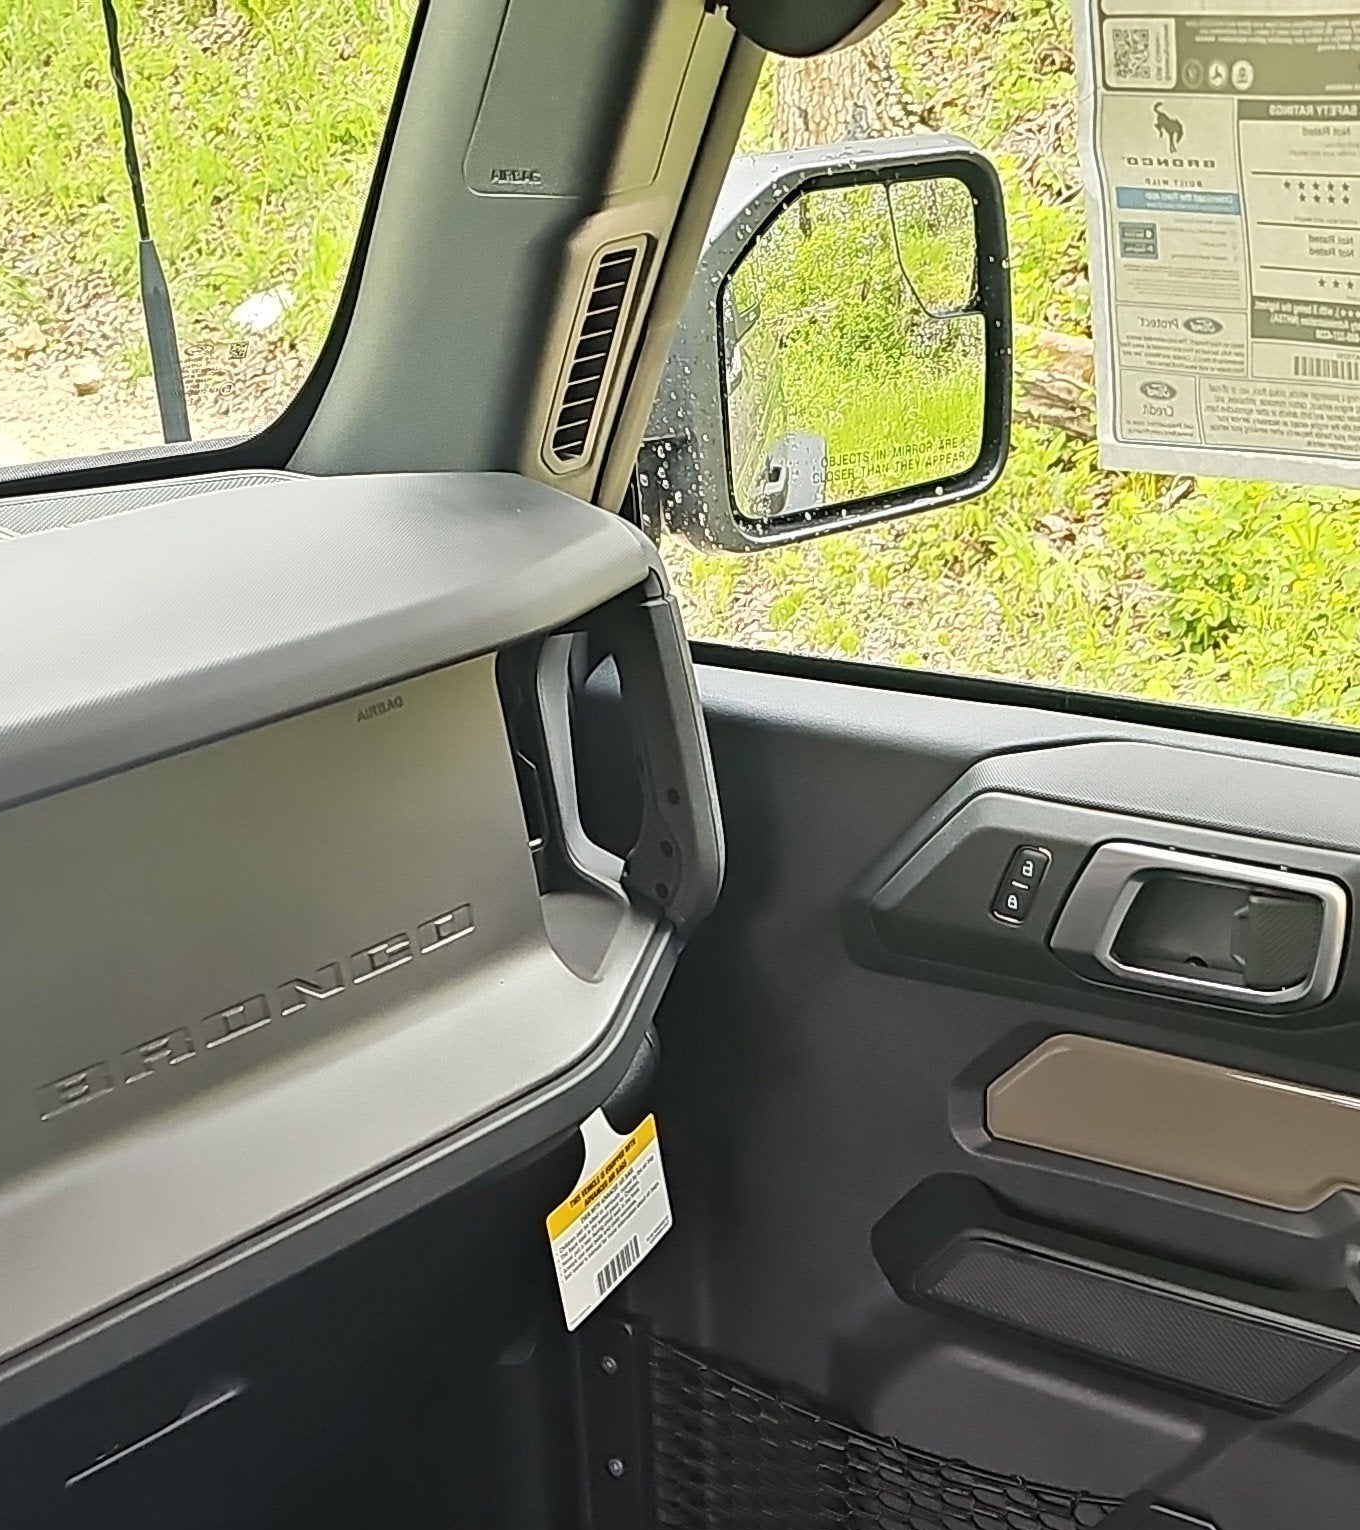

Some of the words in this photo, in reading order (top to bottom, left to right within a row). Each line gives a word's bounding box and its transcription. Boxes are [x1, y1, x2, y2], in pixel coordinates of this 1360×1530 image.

[812, 468, 855, 484] CLOSER
[861, 462, 890, 477] THAN
[894, 457, 921, 473] THEY
[925, 451, 966, 467] APPEAR
[820, 452, 870, 468] OBJECTS
[876, 450, 887, 460] IN
[893, 441, 934, 457] MIRROR
[938, 437, 959, 450] ARE
[36, 902, 475, 1121] BRONCO
